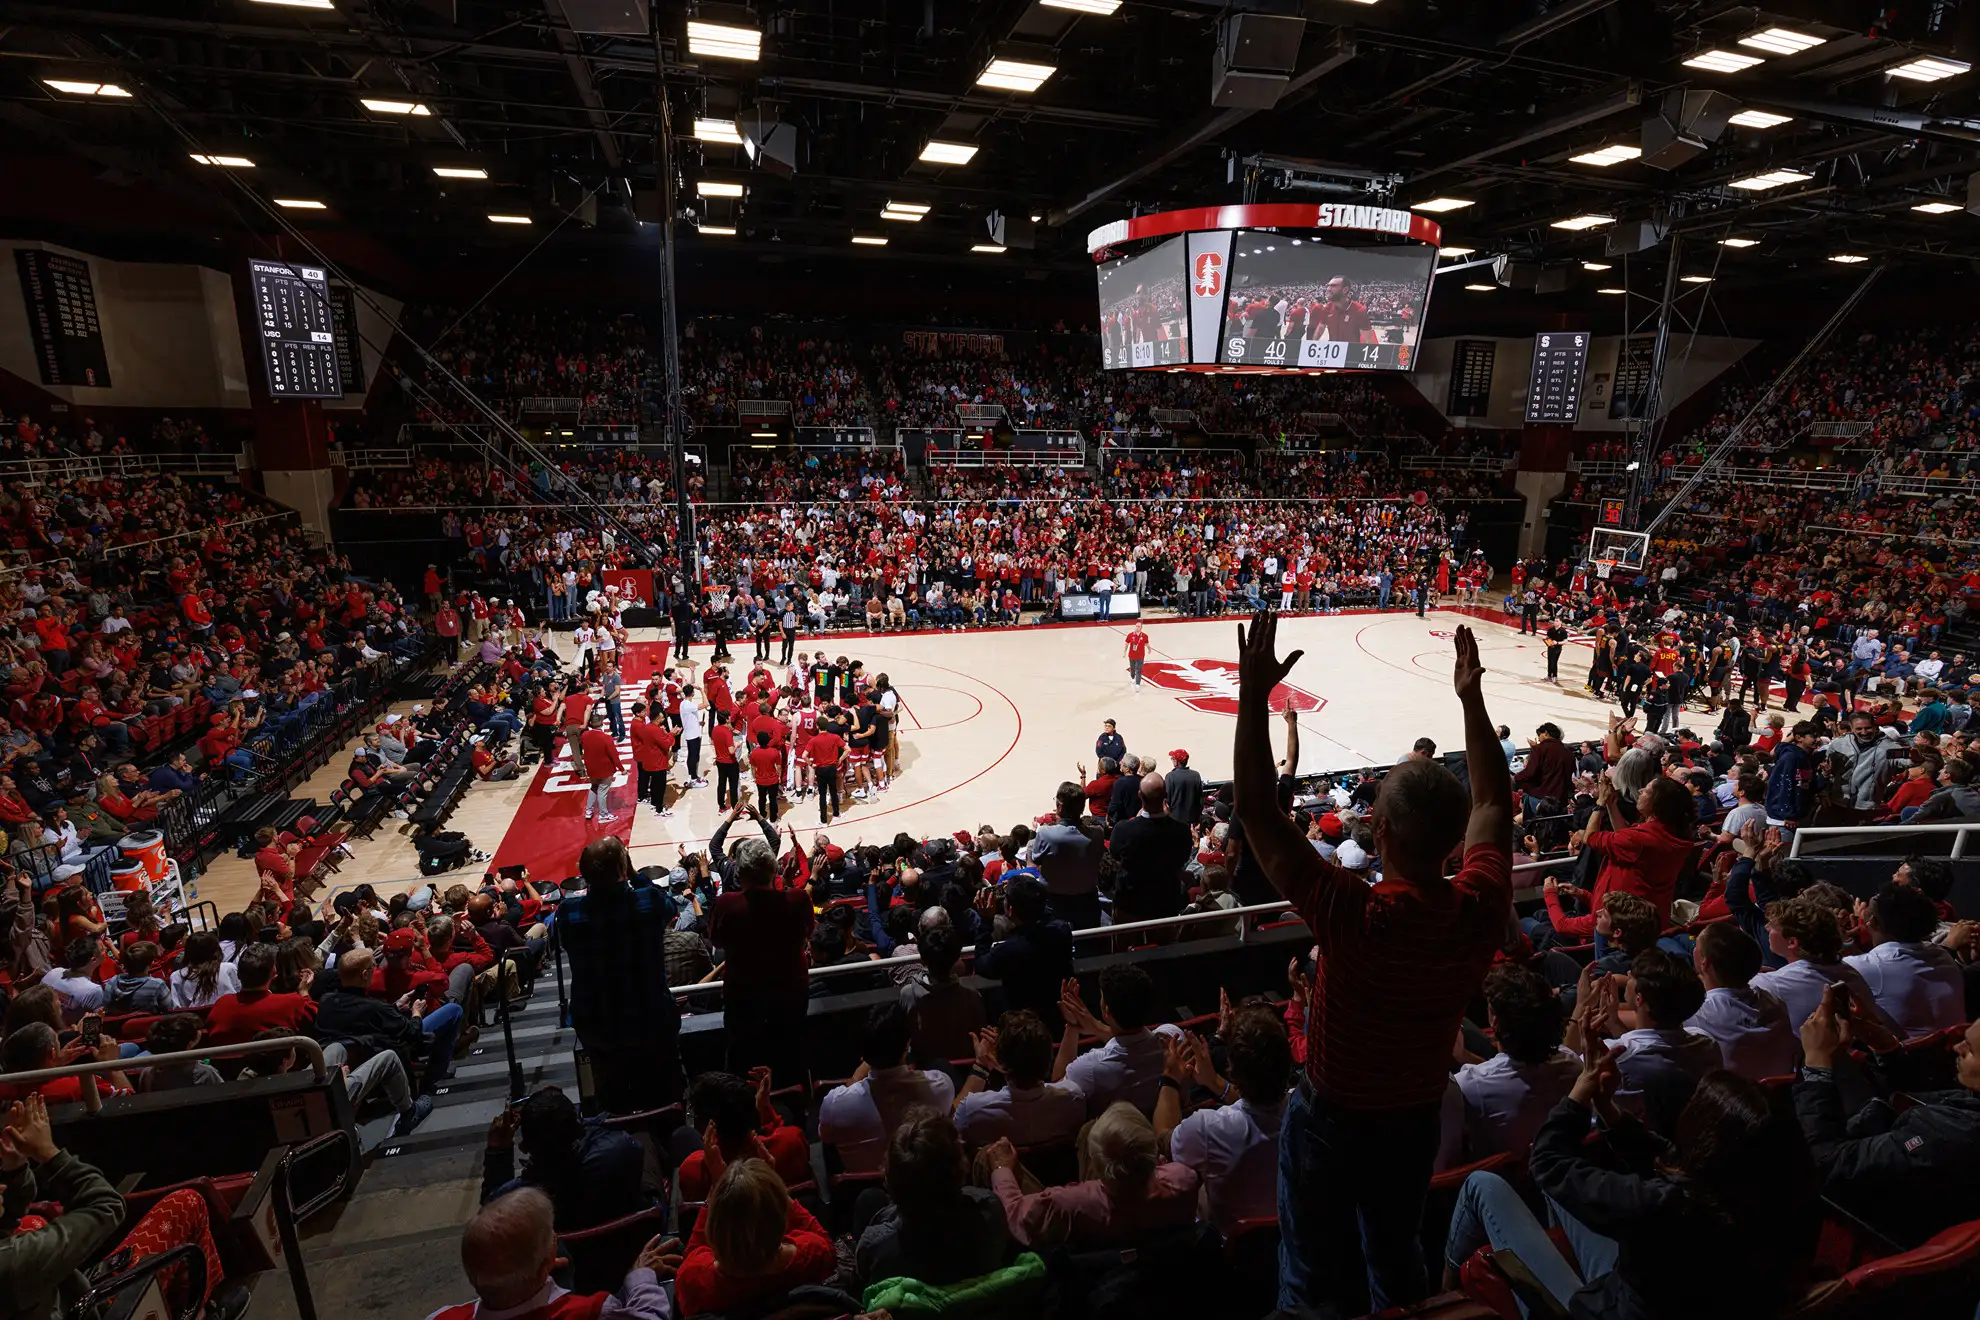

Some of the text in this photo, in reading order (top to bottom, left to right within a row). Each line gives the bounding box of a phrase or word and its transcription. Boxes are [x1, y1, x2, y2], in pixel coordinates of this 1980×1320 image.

[1318, 203, 1411, 234] STANFORD
[902, 330, 1004, 357] STANFORD
[1119, 348, 1127, 361] 40
[1136, 345, 1150, 359] 6:10
[1161, 342, 1170, 358] 14
[1228, 338, 1246, 357] S
[1265, 341, 1286, 357] 40
[1308, 344, 1340, 358] 6:10
[1362, 346, 1379, 361] 14
[1541, 336, 1550, 347] S
[804, 718, 813, 729] 13
[295, 1108, 311, 1136] 1
